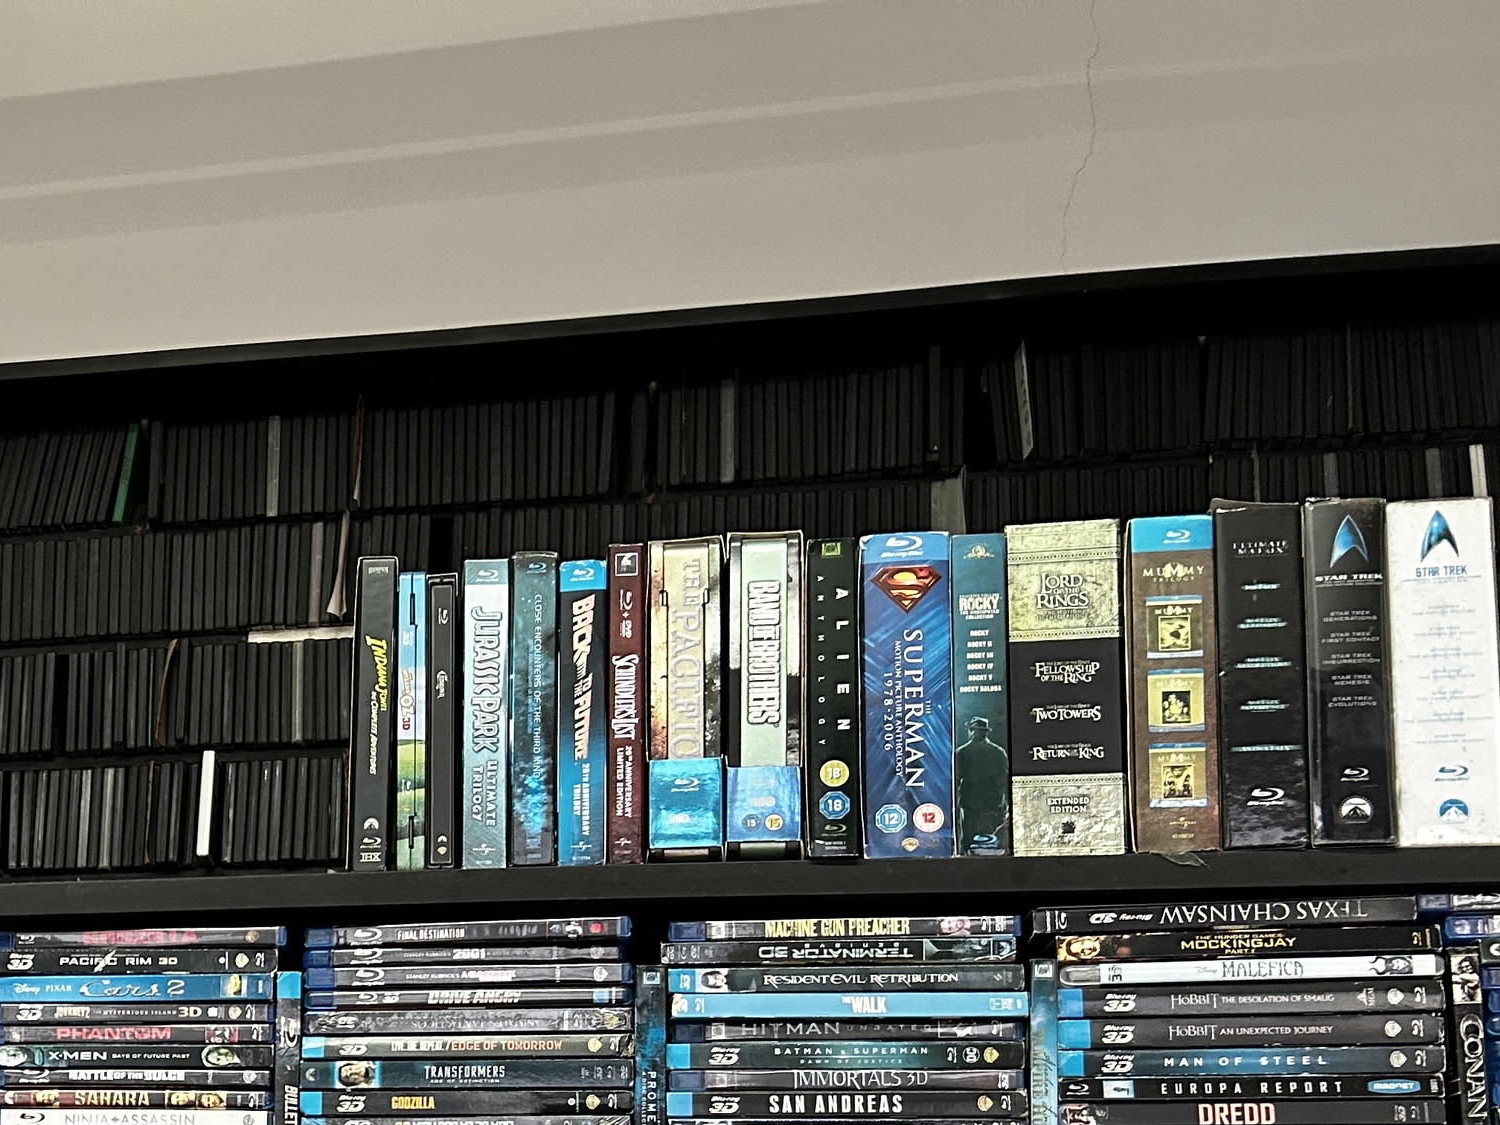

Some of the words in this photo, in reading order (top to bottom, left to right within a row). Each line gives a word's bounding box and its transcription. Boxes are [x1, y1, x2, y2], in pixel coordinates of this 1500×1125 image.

[1316, 574, 1347, 582] STAR
[1352, 573, 1383, 581] TREK
[959, 596, 1000, 611] ROCKY
[470, 606, 503, 697] JURASSIC
[817, 575, 826, 745] ANTHOLOGY
[836, 587, 851, 731] ALIEN
[903, 629, 925, 789] SUPERMAN
[472, 698, 502, 754] PARK
[616, 748, 624, 778] LIMITED
[827, 767, 841, 779] 18
[471, 766, 484, 822] TRILOGY
[486, 759, 496, 827] ULTIMATE
[616, 781, 624, 817] EDITION
[624, 763, 634, 819] ANNIVERSARY
[827, 799, 842, 812] 18
[1047, 796, 1090, 806] EXTENDED
[1050, 805, 1087, 813] EDITION
[883, 812, 899, 825] 12
[922, 812, 936, 824] 12
[56, 1027, 172, 1040] PHANTOM
[1164, 1057, 1203, 1067] MAN
[1219, 1057, 1244, 1066] OF
[1260, 1055, 1327, 1066] STEEL
[1161, 1082, 1243, 1095] EUROPA
[1260, 1081, 1343, 1093] REPORT
[391, 1096, 436, 1109] GODZILLA
[769, 1095, 806, 1113] SAN
[815, 1095, 904, 1113] ANDREAS
[1198, 1103, 1276, 1125] DREDD
